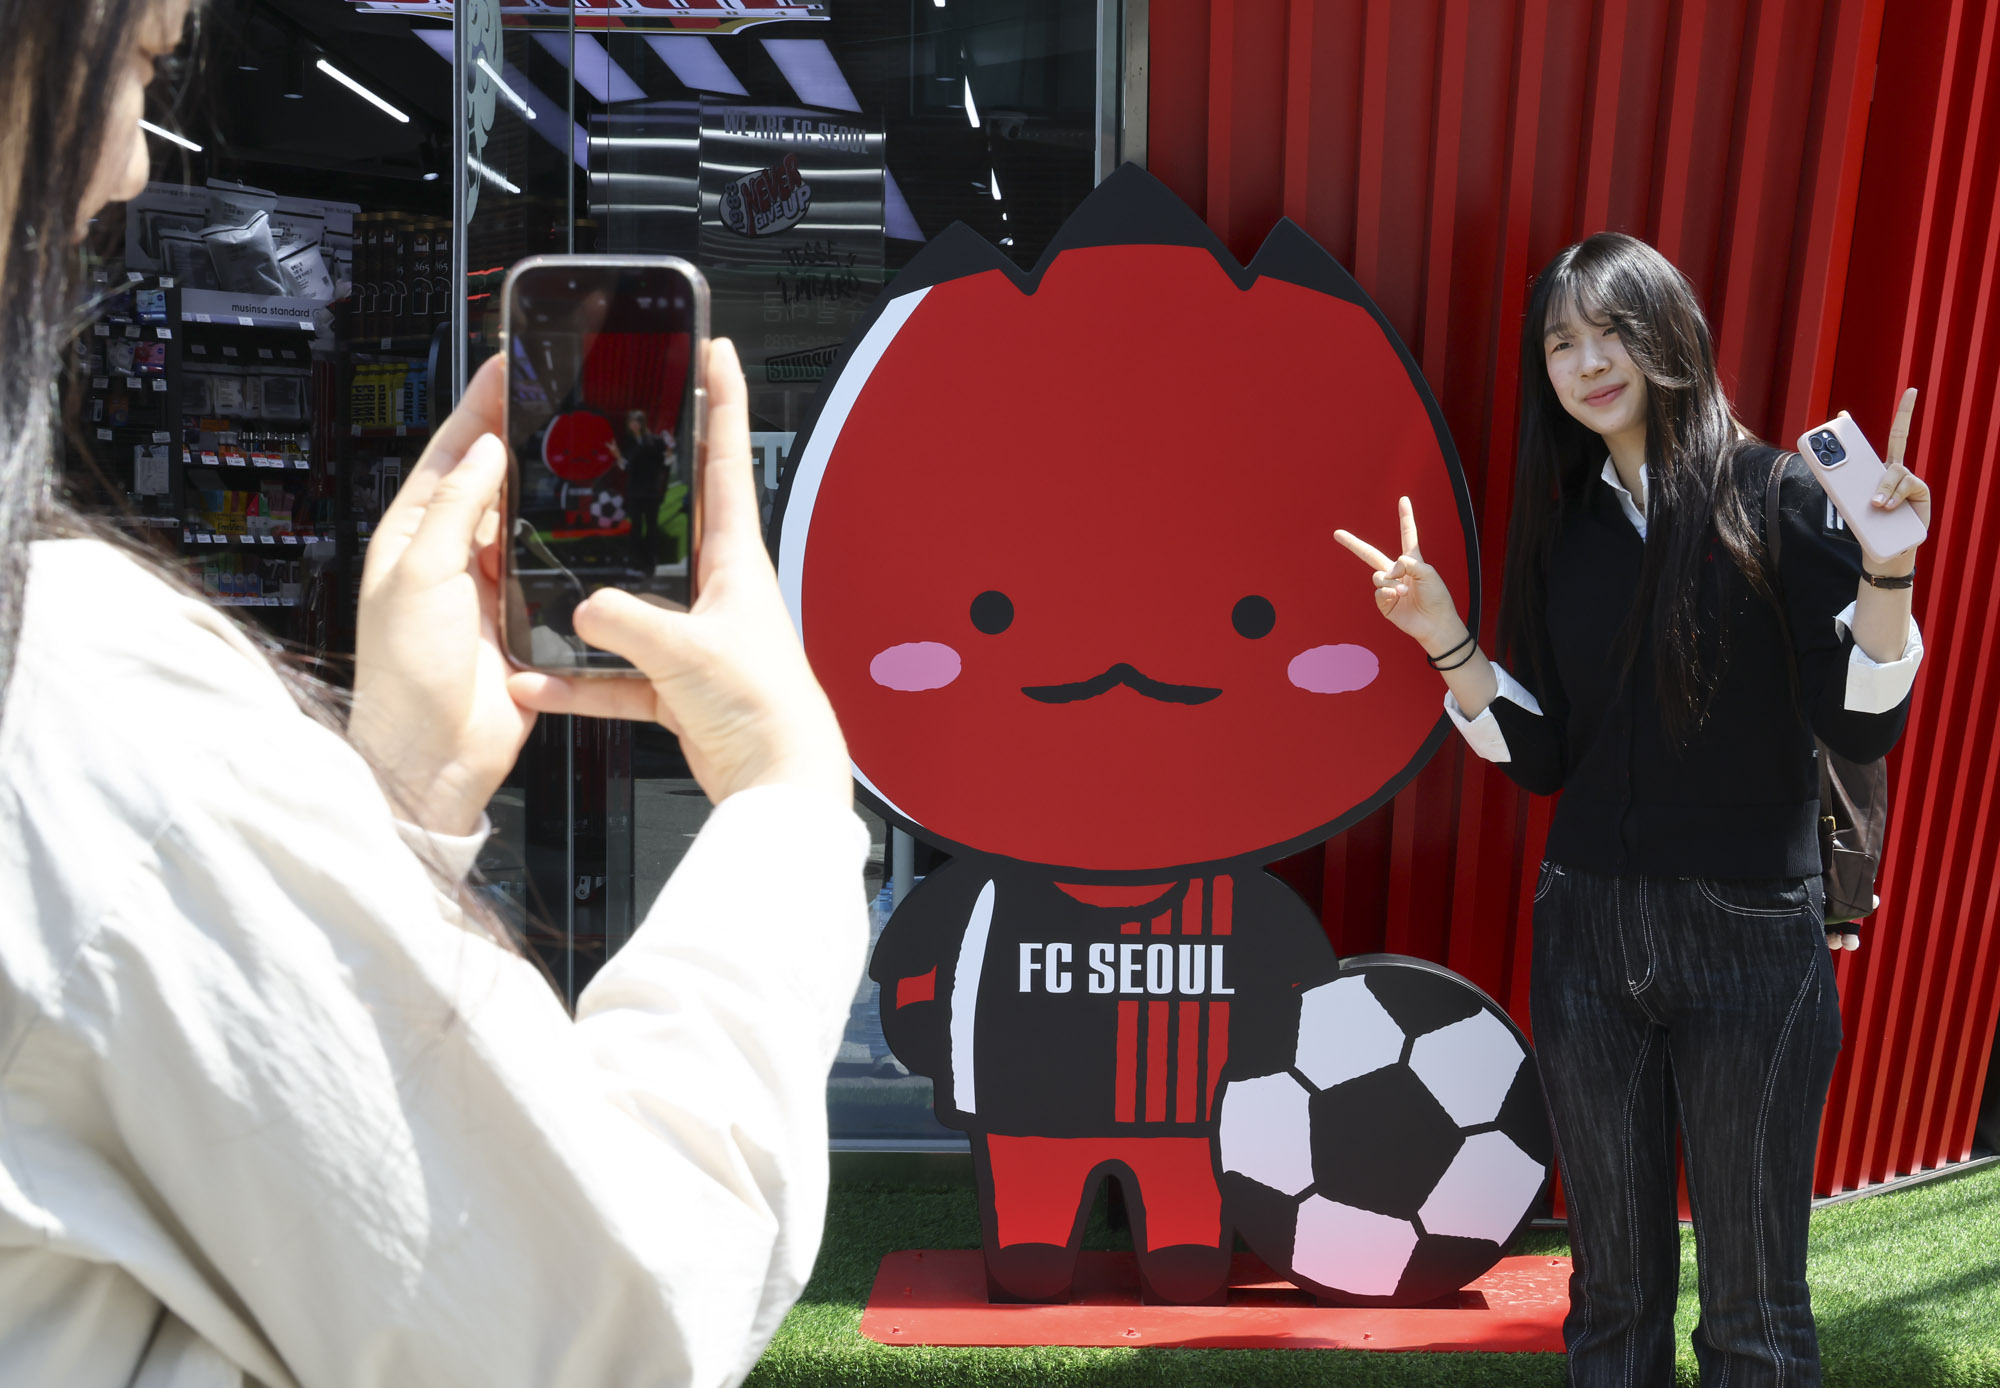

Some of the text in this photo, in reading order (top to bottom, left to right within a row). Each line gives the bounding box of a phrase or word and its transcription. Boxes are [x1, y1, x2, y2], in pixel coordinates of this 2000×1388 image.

[723, 109, 869, 154] WE ARE FC SEOUL
[724, 182, 745, 231] 1983
[741, 152, 802, 237] NEVER
[754, 184, 812, 230] GIVE UP
[231, 303, 310, 318] musinsa standard
[1018, 942, 1235, 995] FC SEOUL
